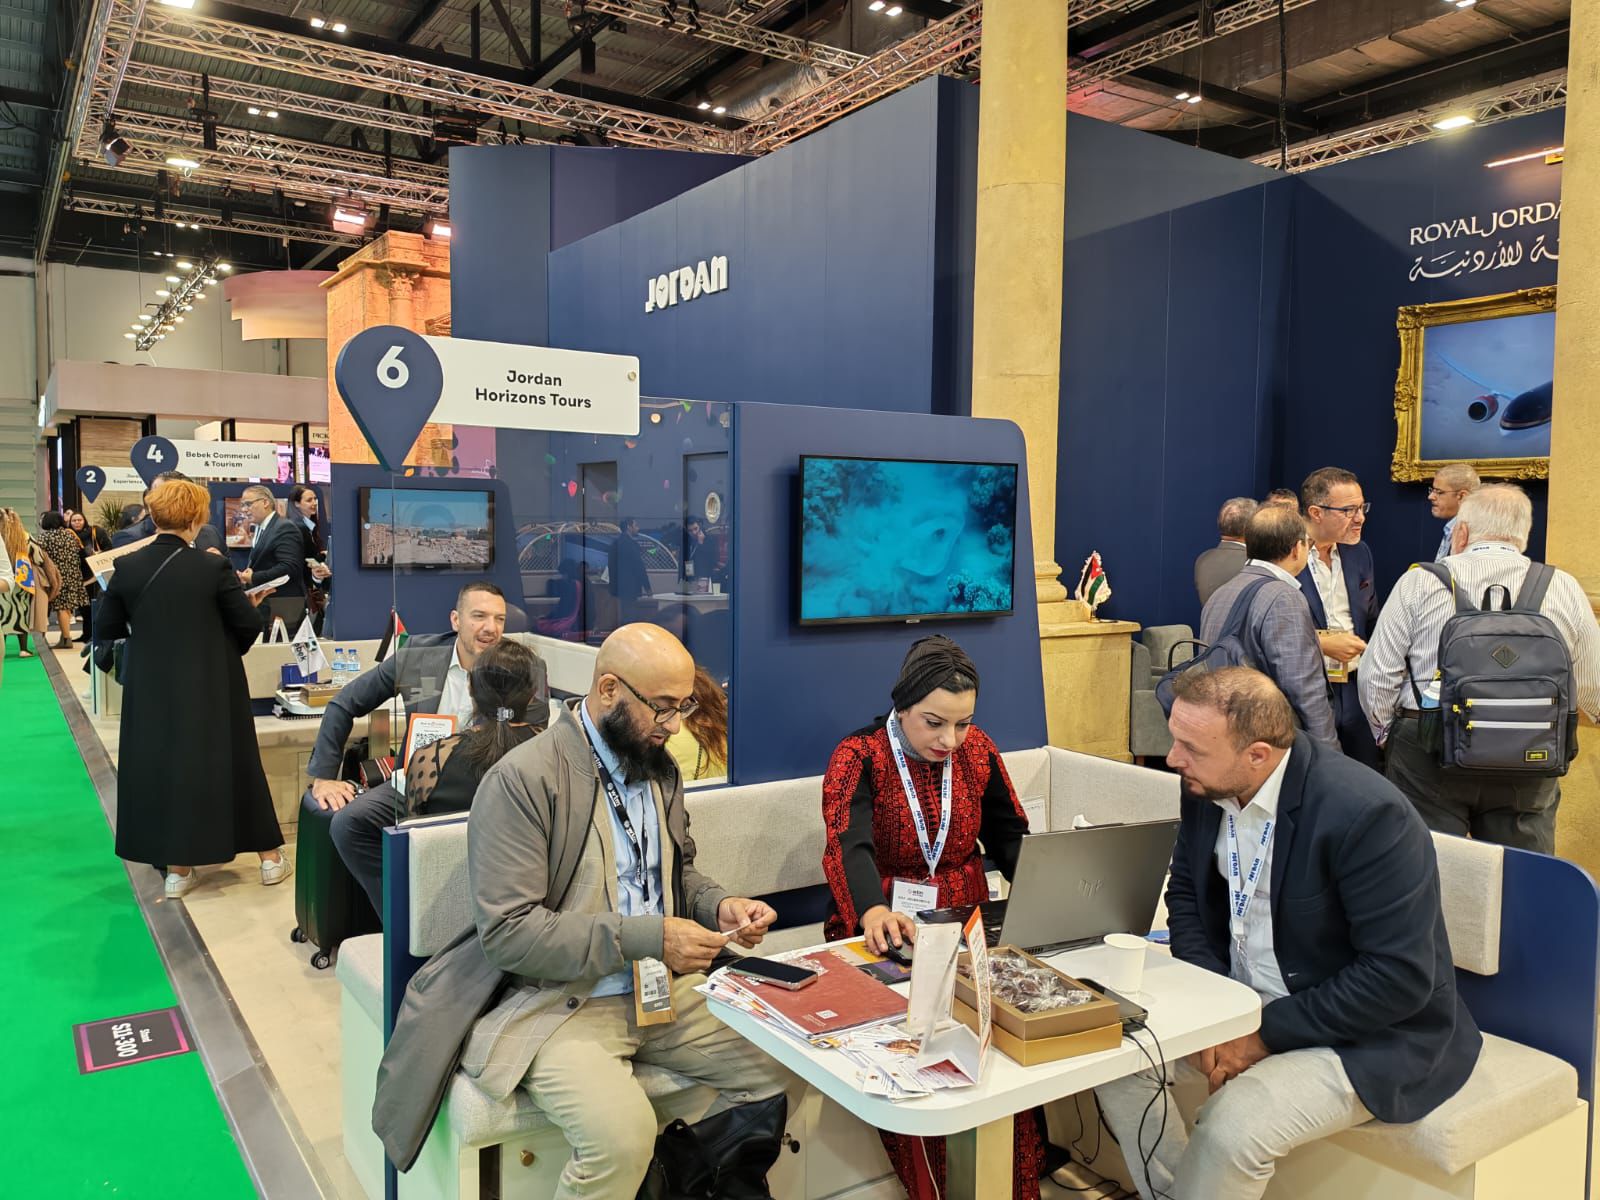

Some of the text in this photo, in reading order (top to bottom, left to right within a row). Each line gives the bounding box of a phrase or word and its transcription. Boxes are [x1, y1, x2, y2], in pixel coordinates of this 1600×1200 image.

[1410, 216, 1482, 246] ROYAL
[376, 345, 410, 389] 6
[506, 370, 562, 387] Jordan
[475, 387, 592, 408] Horizons Tours
[146, 444, 164, 463] 4
[213, 452, 260, 460] Commercial
[85, 470, 96, 483] 2
